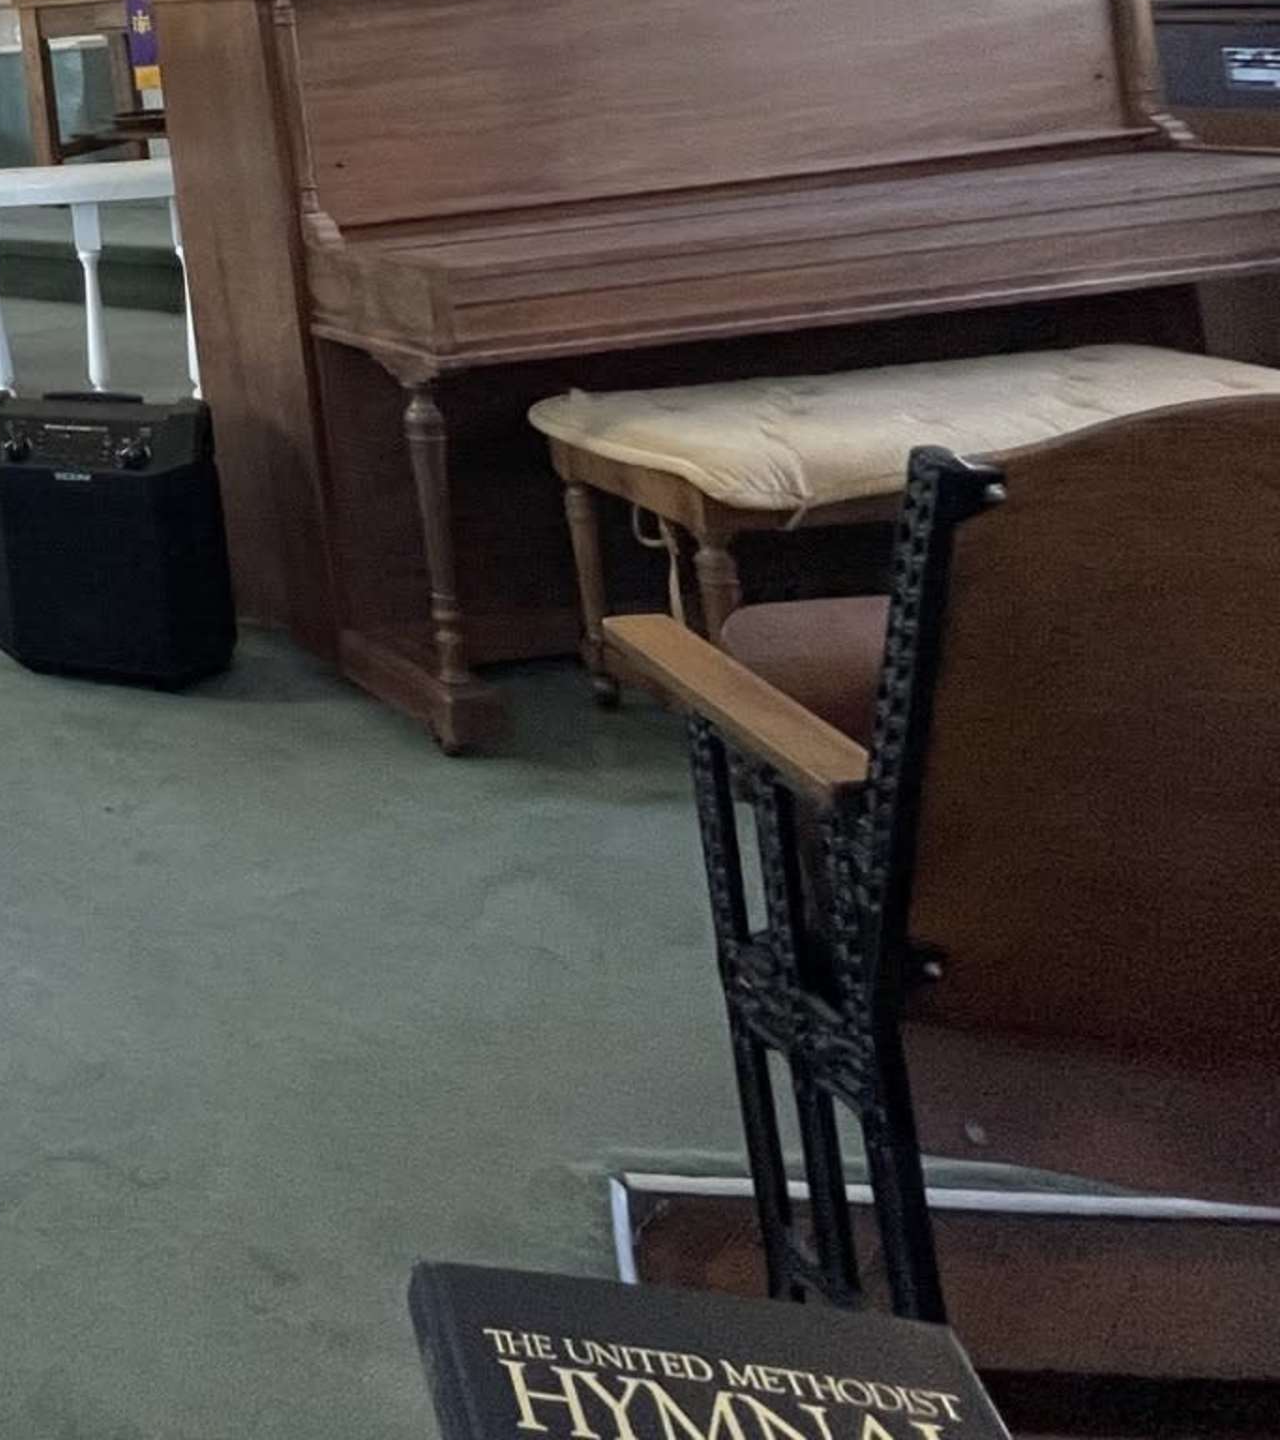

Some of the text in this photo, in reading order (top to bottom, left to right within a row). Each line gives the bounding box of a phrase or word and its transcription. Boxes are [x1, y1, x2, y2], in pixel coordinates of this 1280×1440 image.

[482, 1328, 962, 1422] THE UNITED METHODIST
[498, 1359, 944, 1440] HYMN
